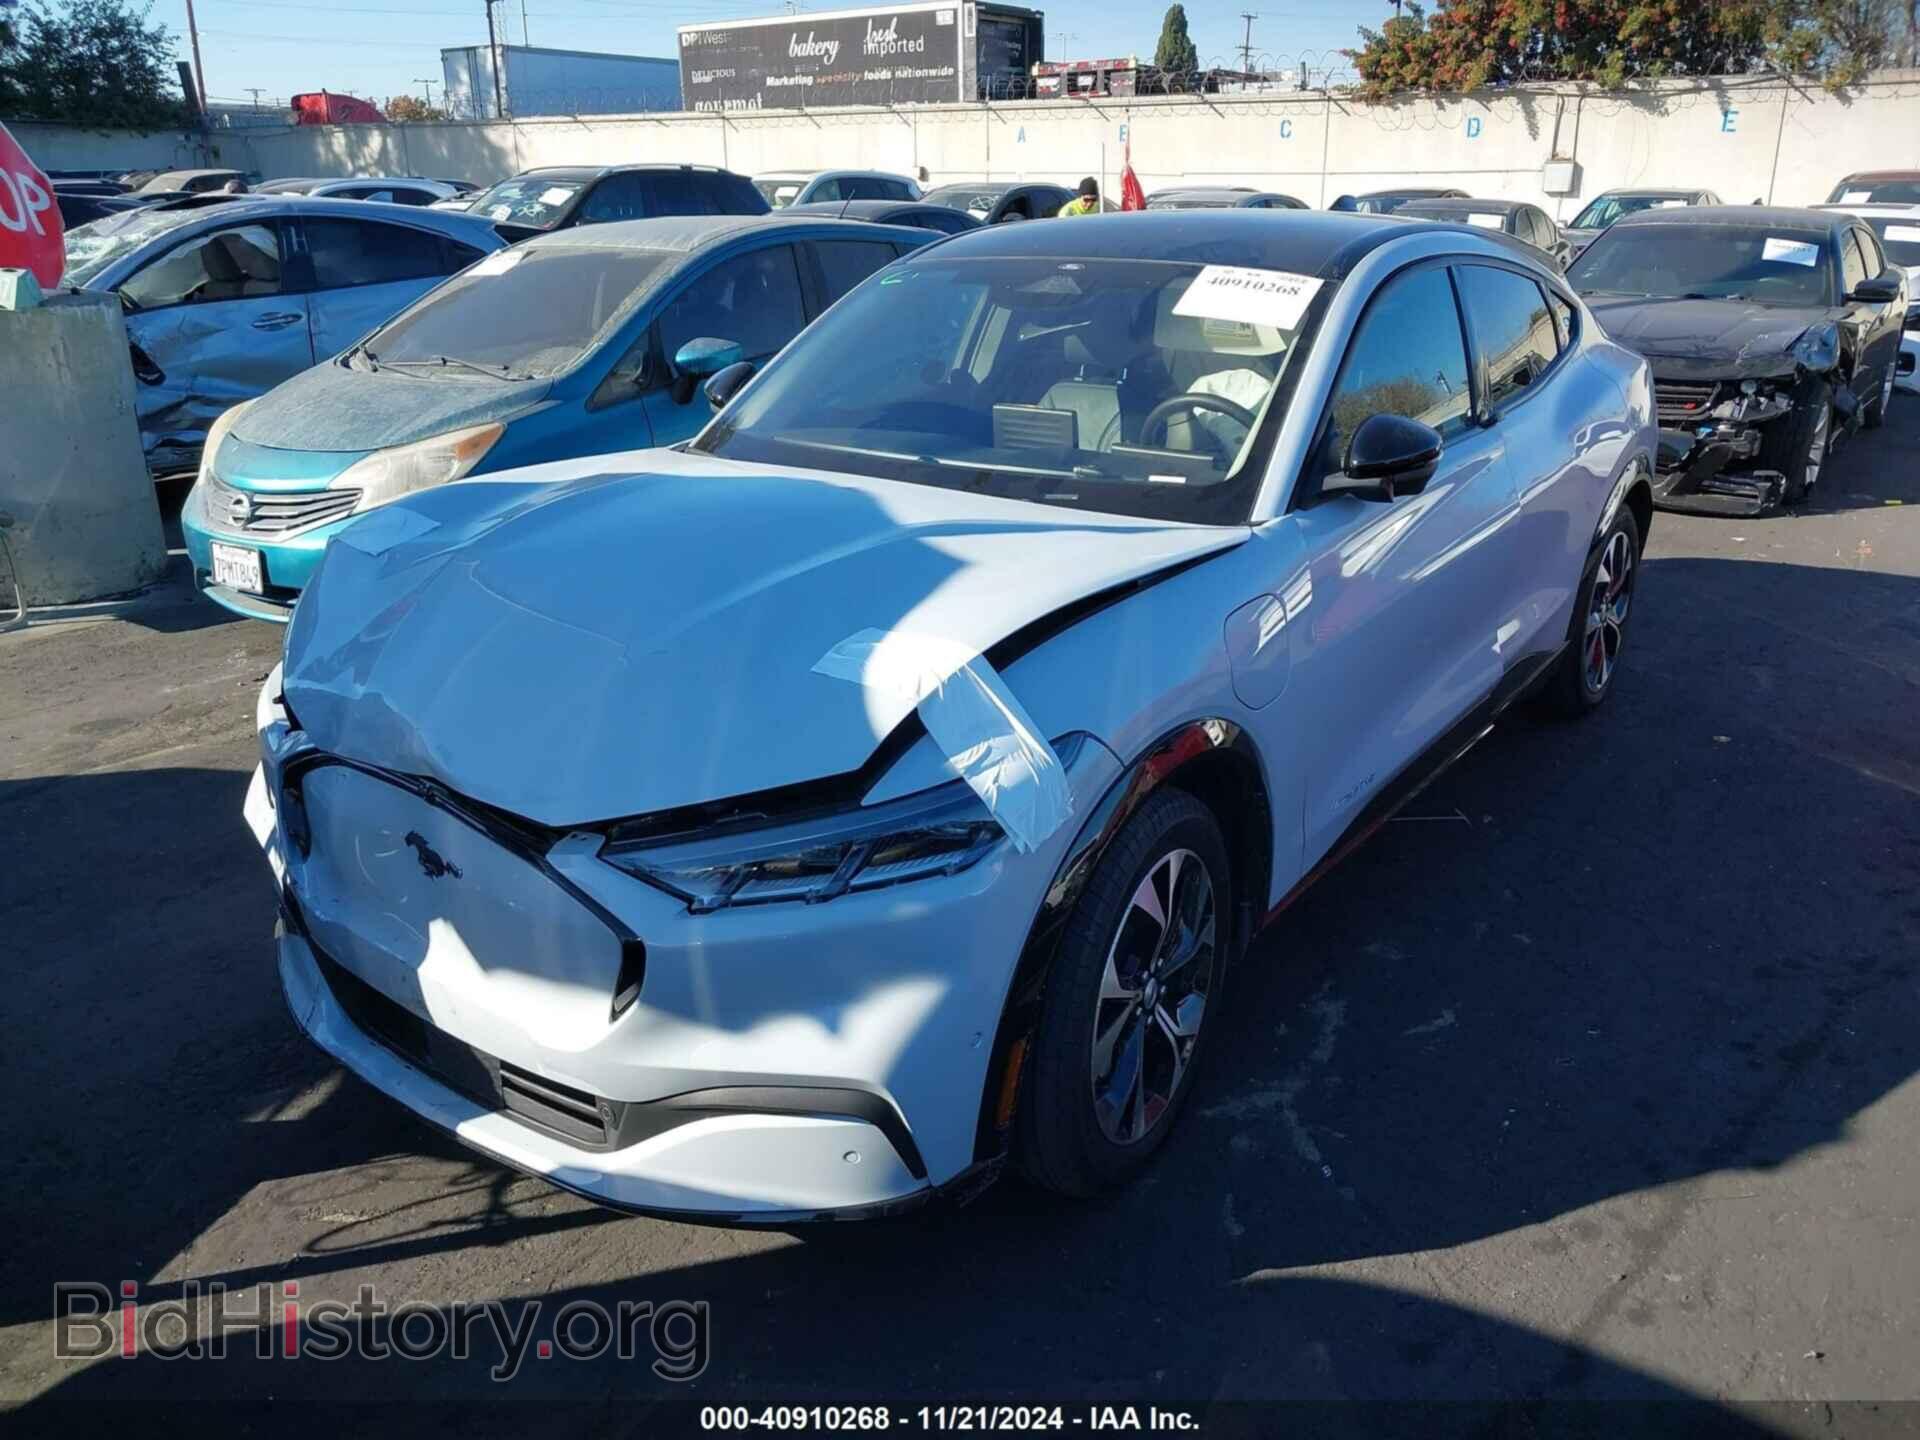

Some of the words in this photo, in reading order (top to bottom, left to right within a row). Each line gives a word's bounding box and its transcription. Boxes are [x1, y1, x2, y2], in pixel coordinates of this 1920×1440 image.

[788, 31, 840, 65] bakery
[863, 35, 924, 58] imported
[766, 74, 814, 87] Marketing
[863, 69, 892, 81] foods
[894, 66, 955, 79] nationwide
[1280, 119, 1293, 139] C
[1466, 117, 1481, 138] D
[1721, 110, 1740, 133] E
[1017, 126, 1026, 143] A
[1206, 275, 1302, 296] 40910268
